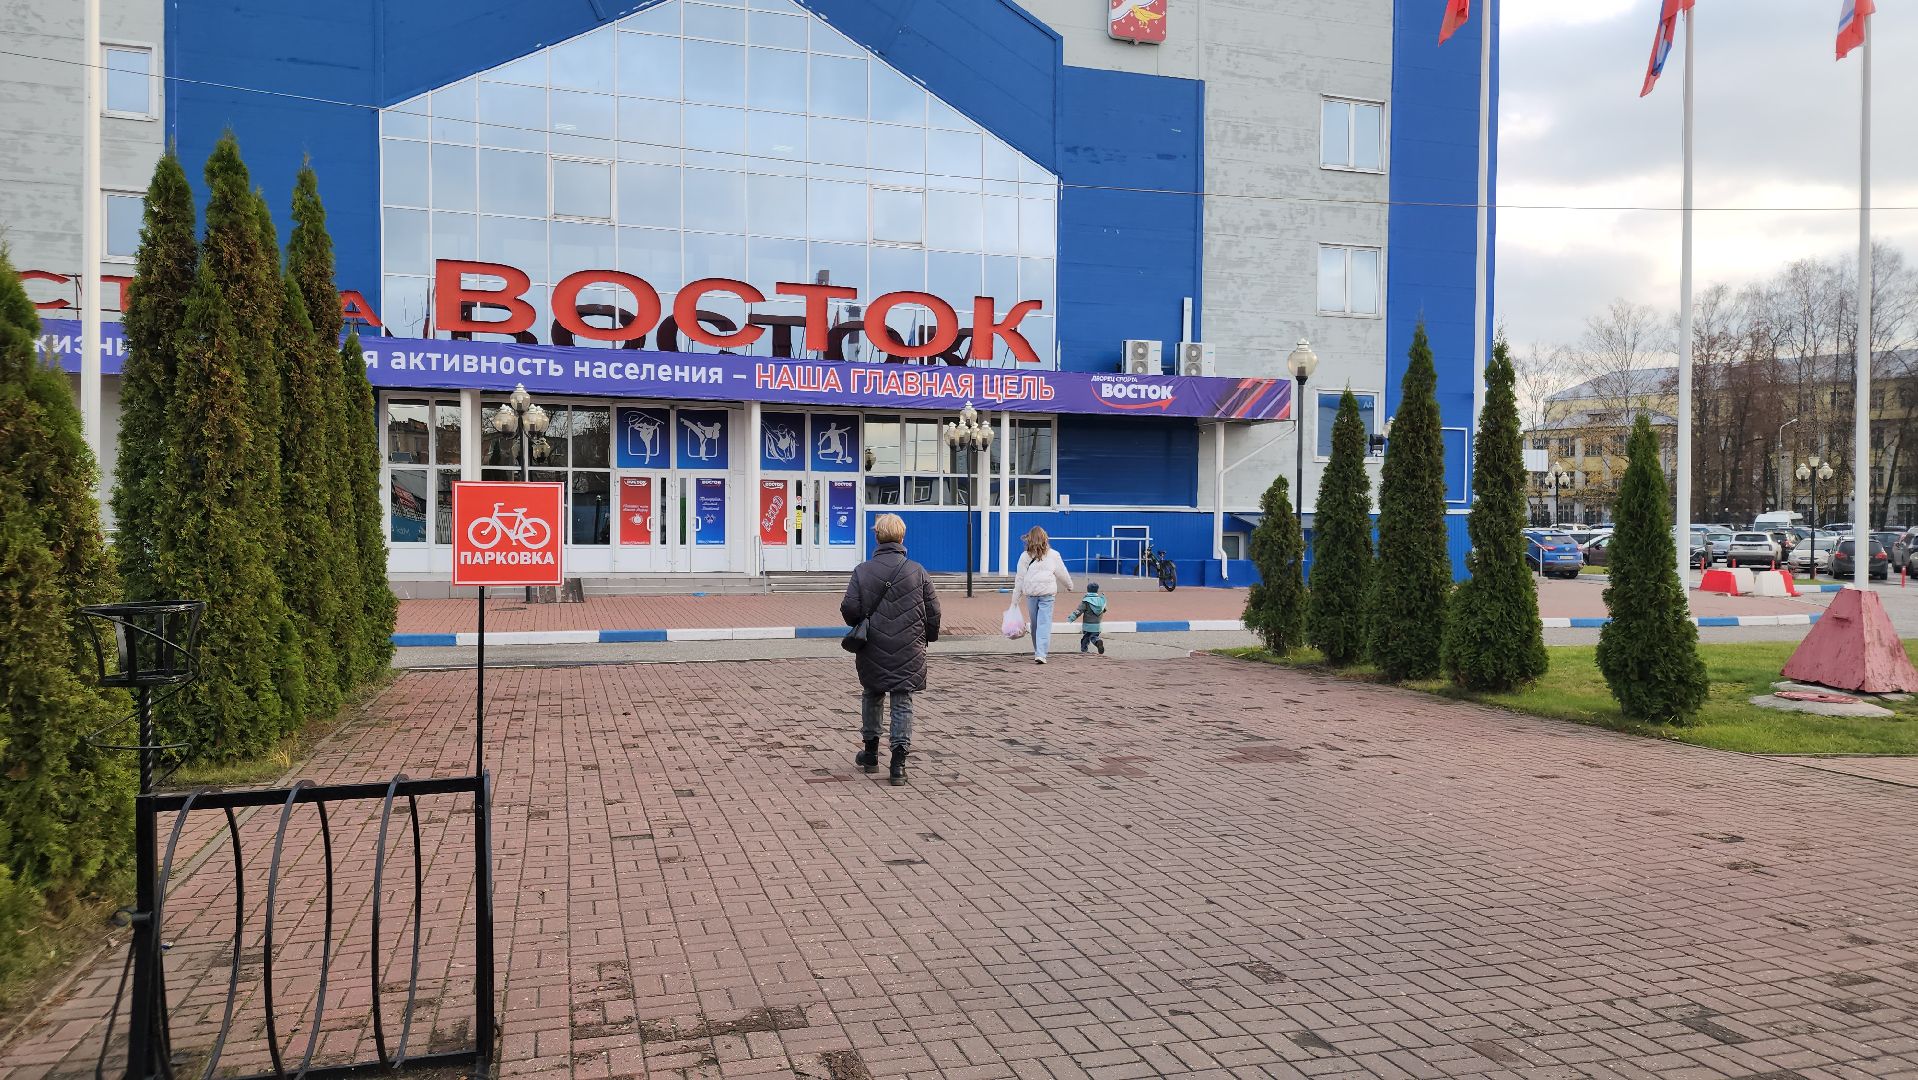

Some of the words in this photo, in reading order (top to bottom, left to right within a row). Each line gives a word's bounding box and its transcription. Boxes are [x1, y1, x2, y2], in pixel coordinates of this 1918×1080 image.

[436, 260, 1042, 363] ВОСТОК
[390, 351, 564, 377] активность
[574, 360, 723, 384] населения
[756, 363, 843, 393] НАША
[851, 368, 975, 399] ГЛАВНАЯ
[983, 374, 1055, 403] ЦЕЛЬ
[1091, 375, 1115, 383] ДВОРЕЦ
[1102, 383, 1174, 400] ВОСТОК
[460, 551, 555, 565] ПАРКОВКА
